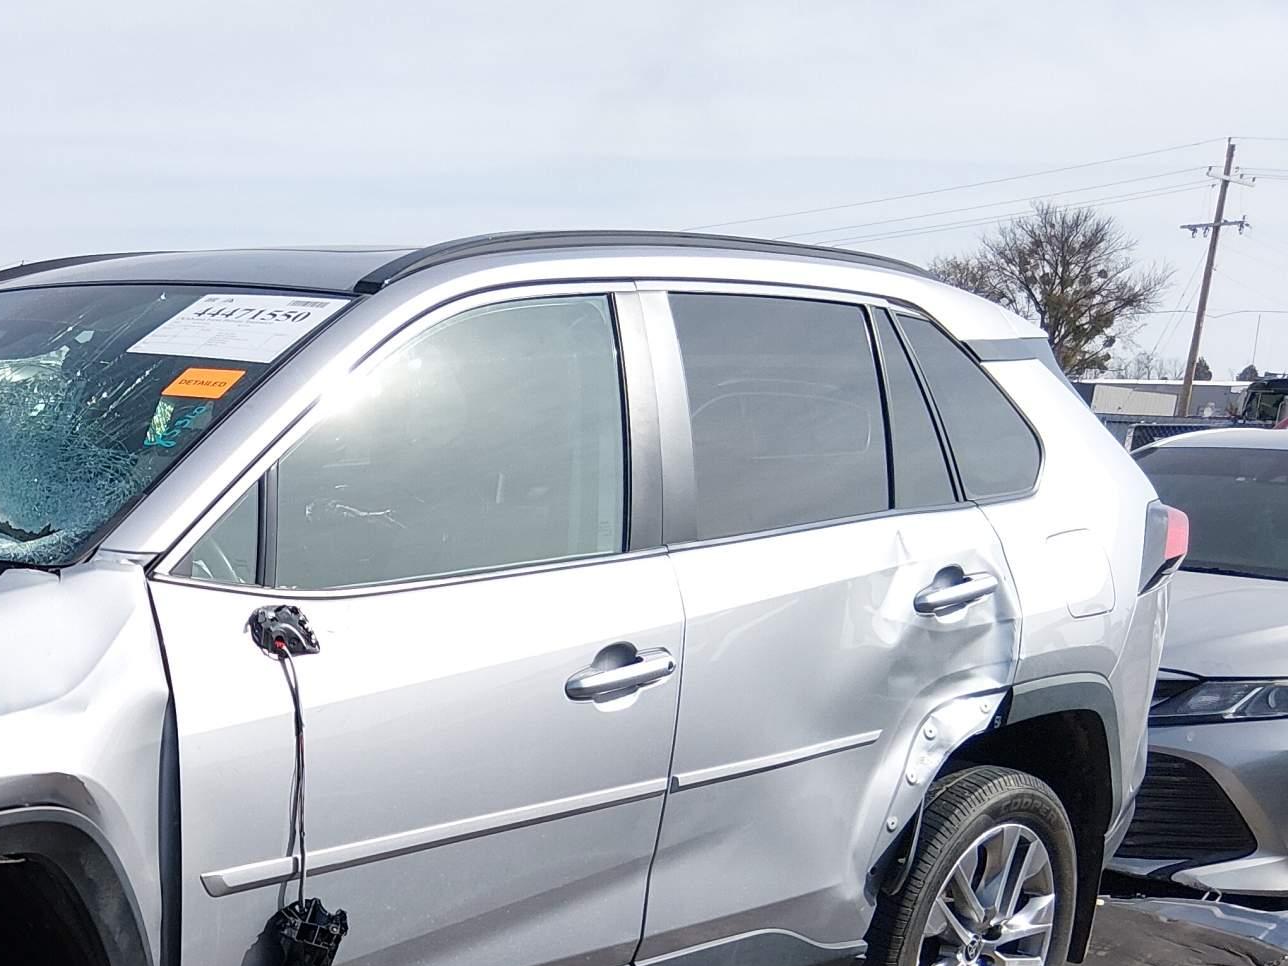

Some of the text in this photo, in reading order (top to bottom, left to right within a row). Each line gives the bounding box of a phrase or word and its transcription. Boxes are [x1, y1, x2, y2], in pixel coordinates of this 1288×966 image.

[193, 306, 312, 323] 44471550
[178, 378, 228, 388] DETAILED
[999, 797, 1058, 825] COOPER
